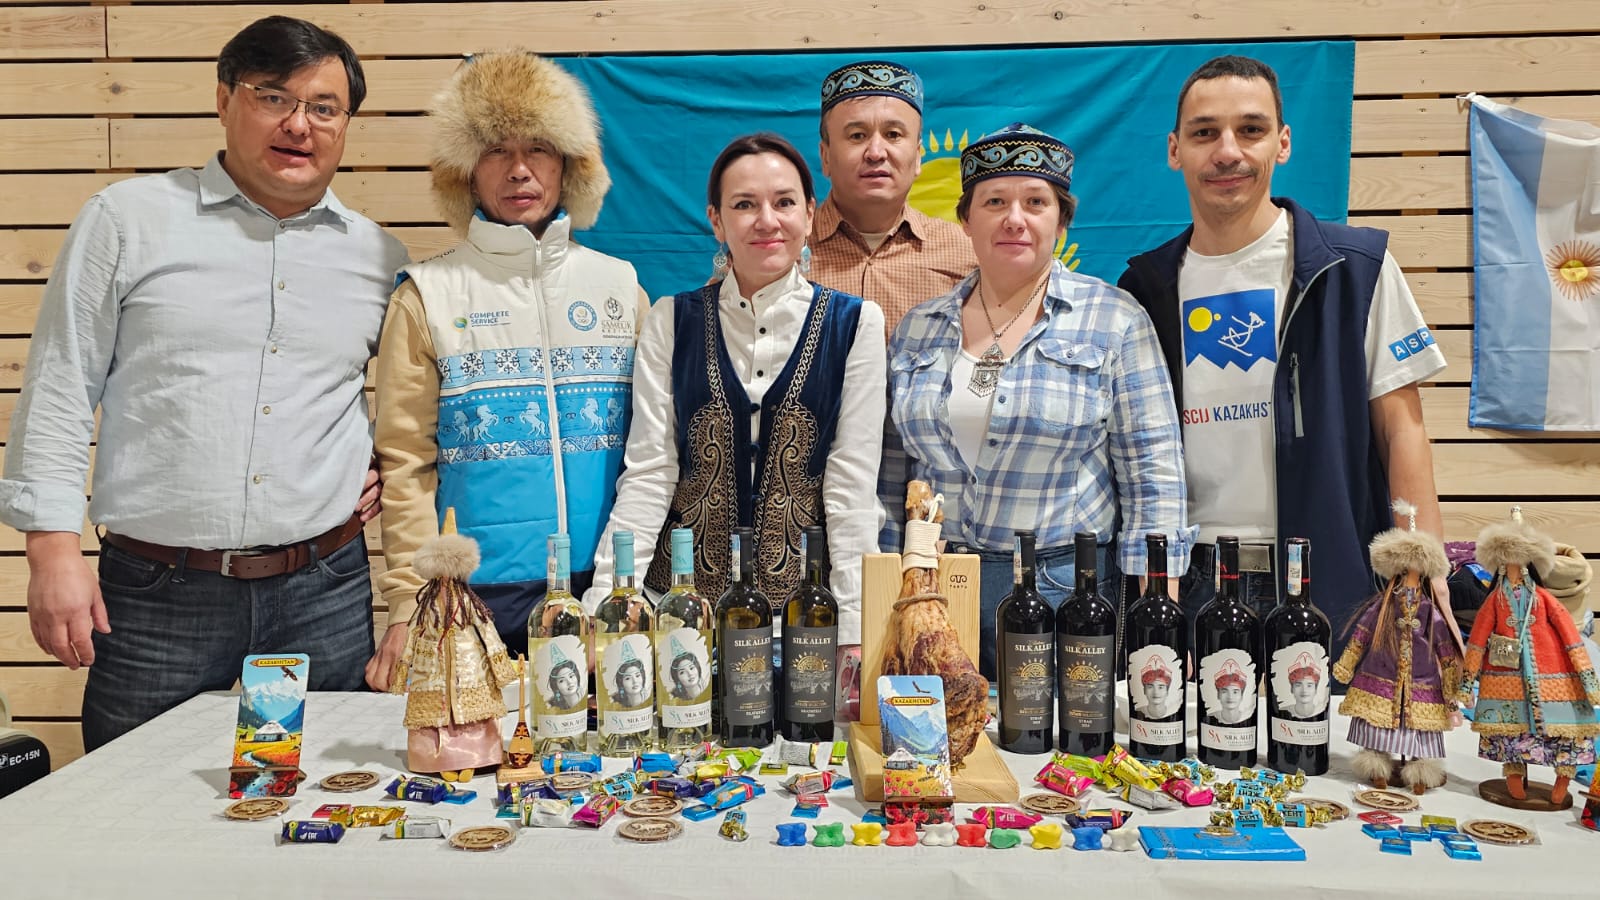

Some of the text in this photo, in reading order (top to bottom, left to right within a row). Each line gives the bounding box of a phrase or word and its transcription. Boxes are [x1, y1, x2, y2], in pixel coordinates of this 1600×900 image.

[469, 310, 510, 318] COMPLETE
[1183, 402, 1272, 424] SCIJ KAZAKHS
[1064, 646, 1106, 655] SILK ALLEY
[1136, 723, 1148, 738] SA
[1208, 728, 1220, 743] SA
[1280, 722, 1293, 736] SA
[10, 749, 40, 766] EC-15N
